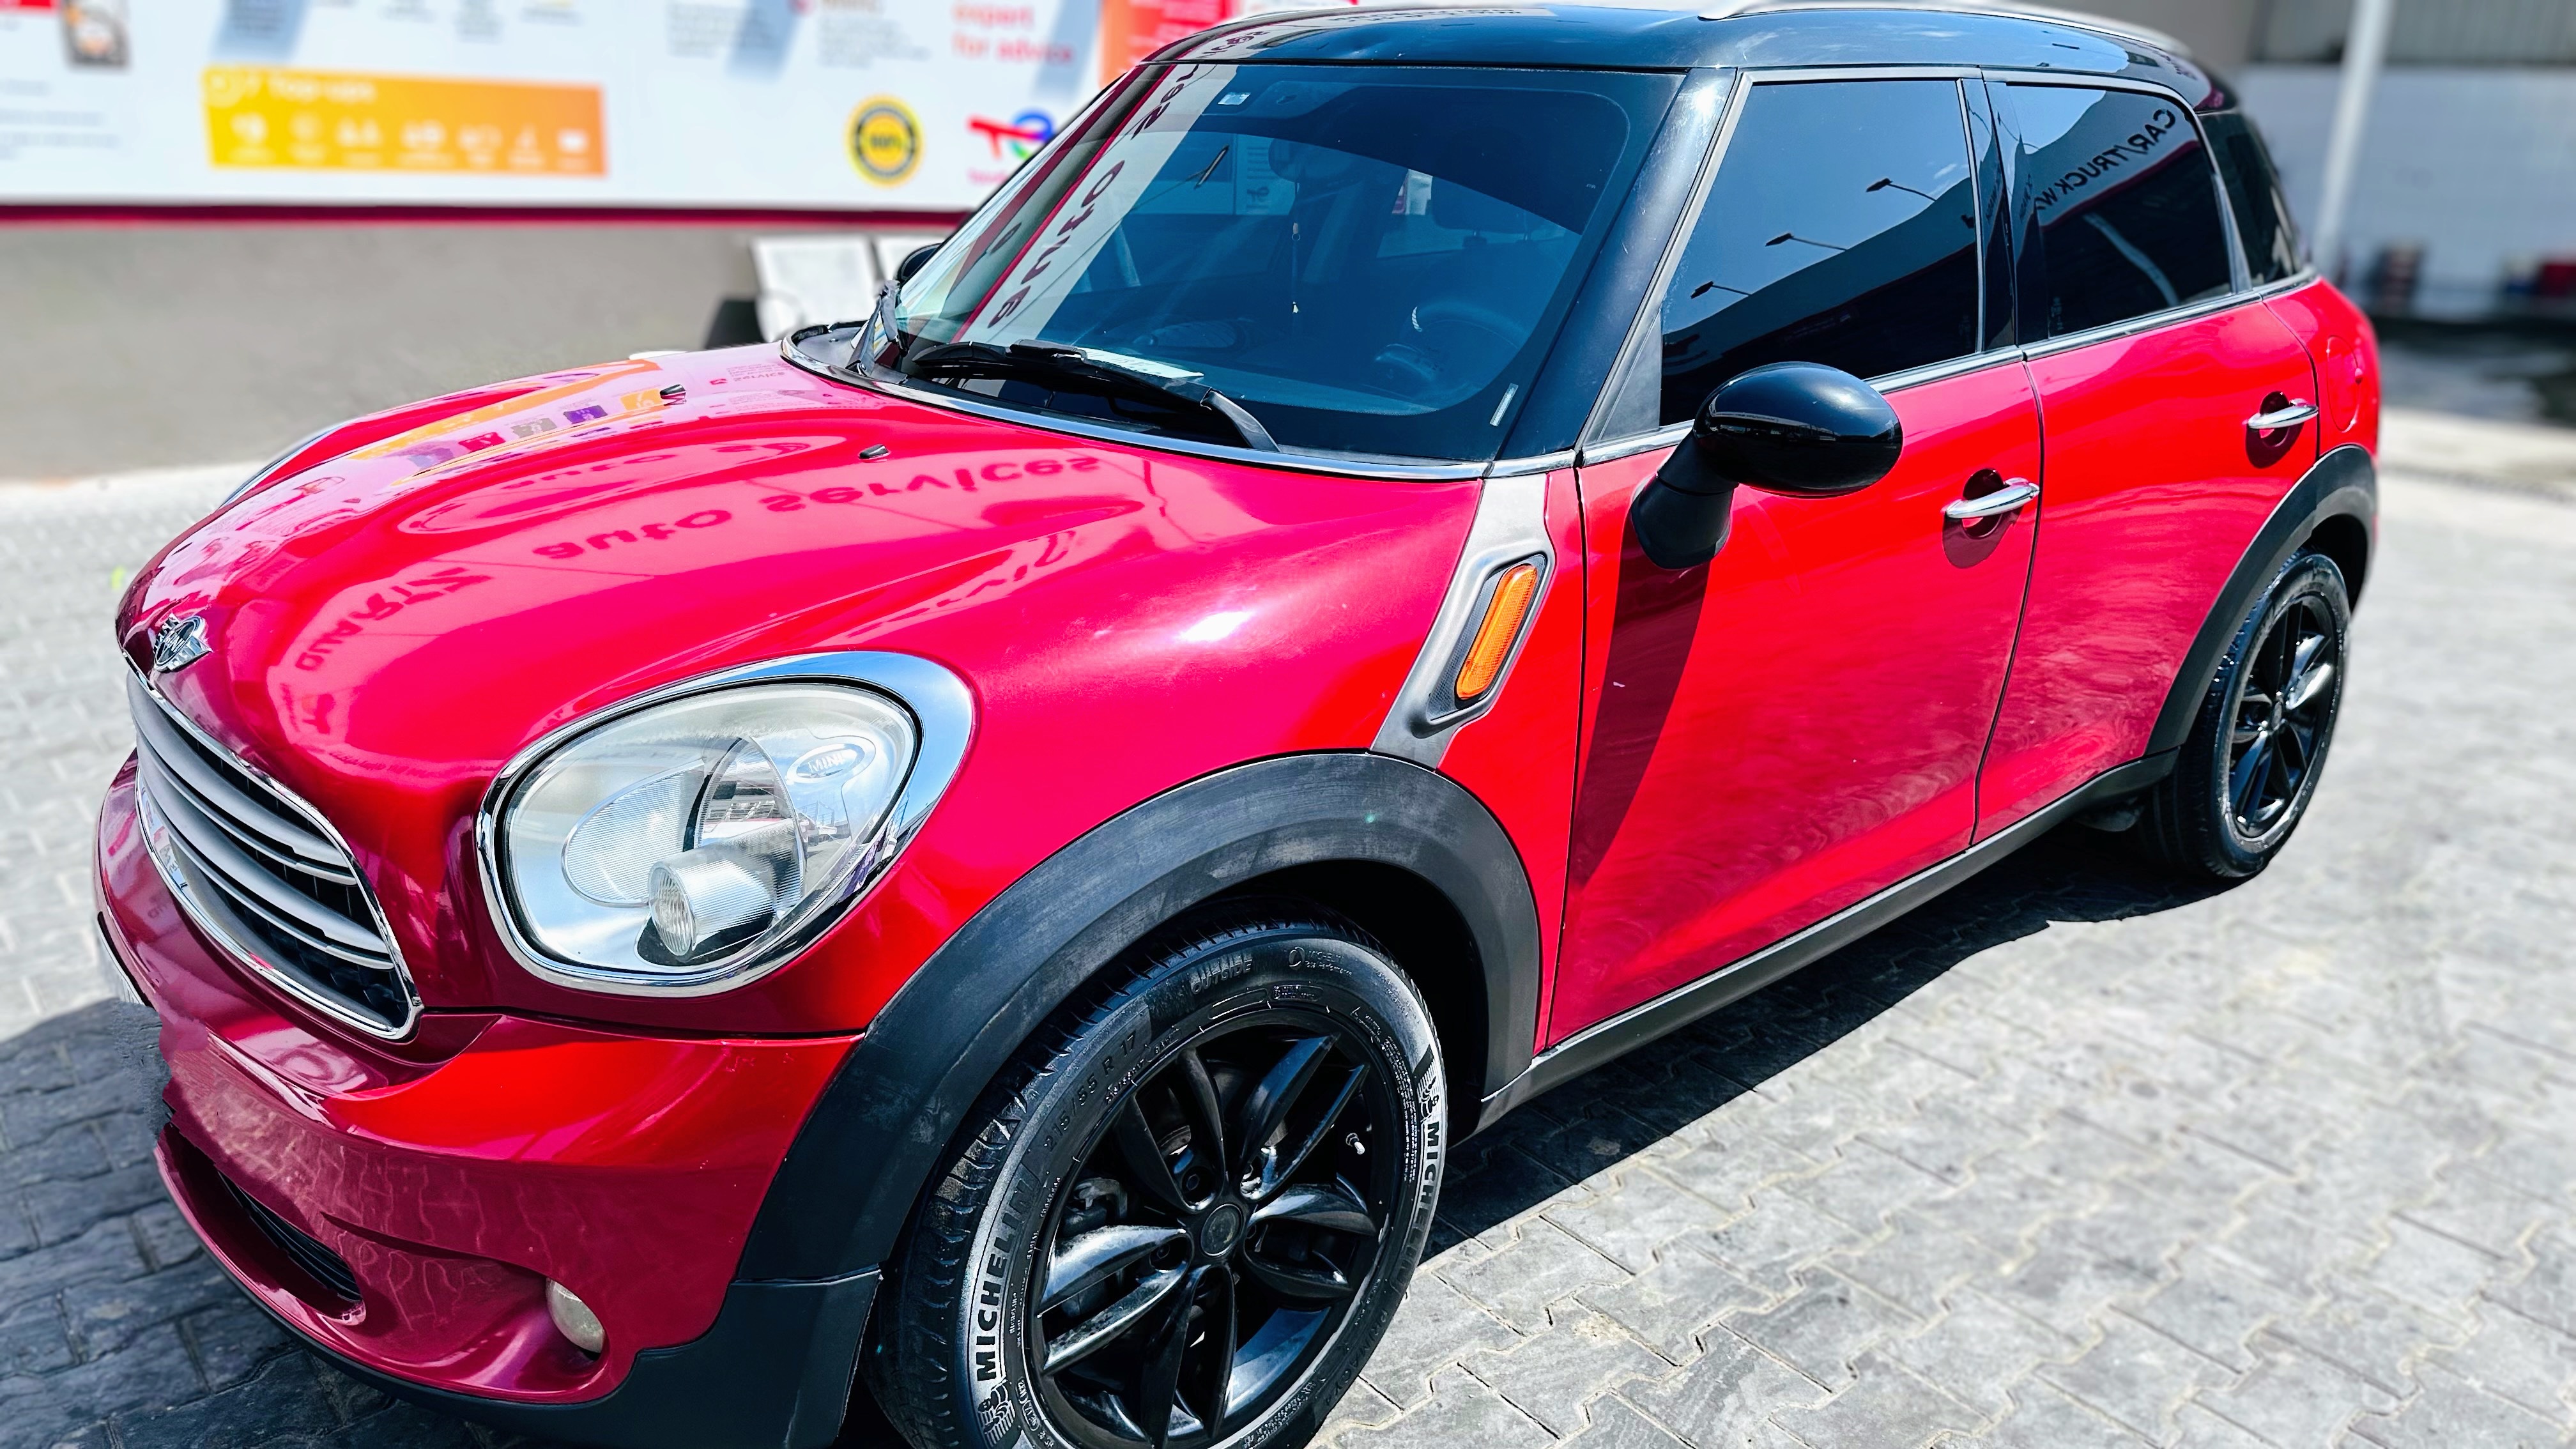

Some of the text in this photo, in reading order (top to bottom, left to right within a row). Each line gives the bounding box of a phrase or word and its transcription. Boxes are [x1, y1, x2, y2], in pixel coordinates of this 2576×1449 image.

[807, 753, 844, 774] MINI
[1190, 956, 1253, 995] OUTSIDE
[1043, 1030, 1136, 1152] 215/55 R 17
[976, 1178, 1034, 1382] MICHELIN
